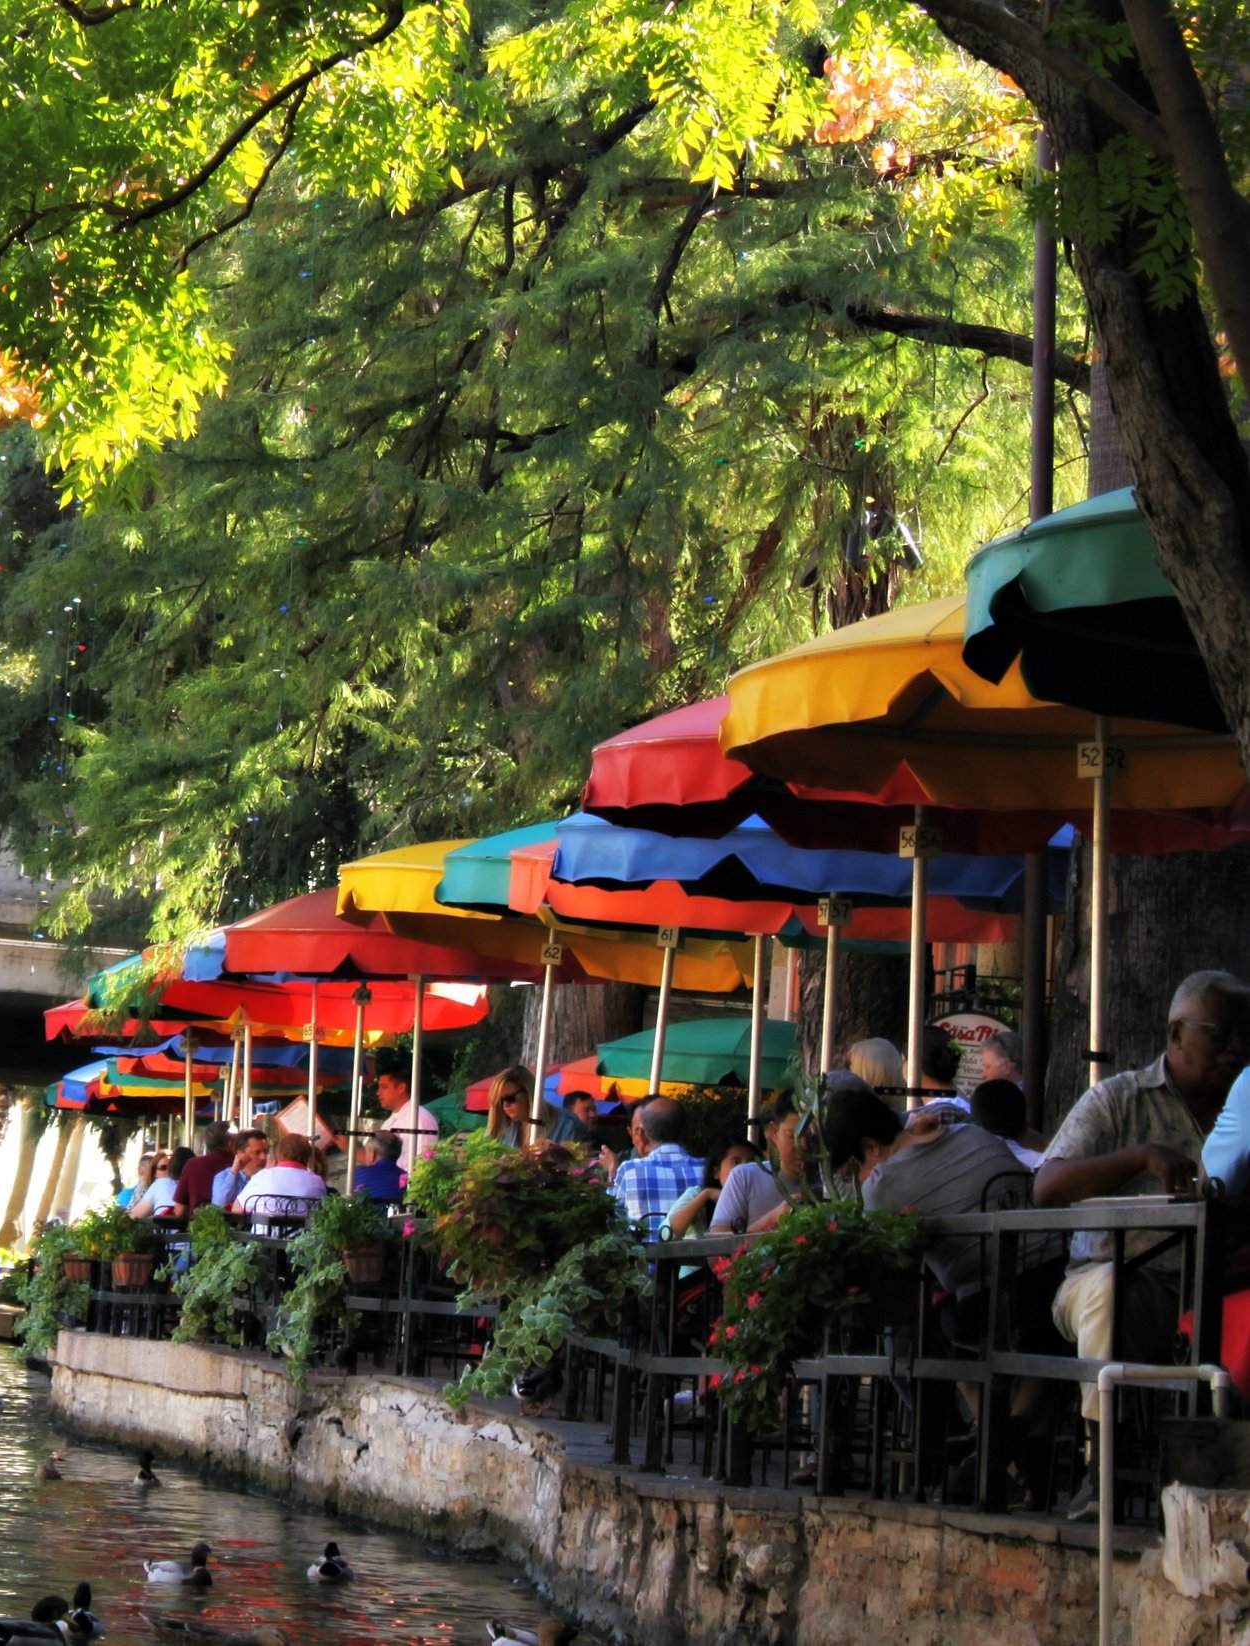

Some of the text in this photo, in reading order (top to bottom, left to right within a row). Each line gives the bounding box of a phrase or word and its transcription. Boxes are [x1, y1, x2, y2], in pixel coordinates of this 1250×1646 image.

[1081, 747, 1100, 767] 52
[1106, 747, 1127, 768] 52
[902, 831, 915, 849] 56
[921, 830, 940, 849] 56
[819, 903, 828, 918] 57
[832, 903, 849, 919] 57
[661, 928, 672, 941] 61
[544, 946, 560, 959] 62
[304, 1025, 313, 1036] 65
[940, 1021, 976, 1041] Casa
